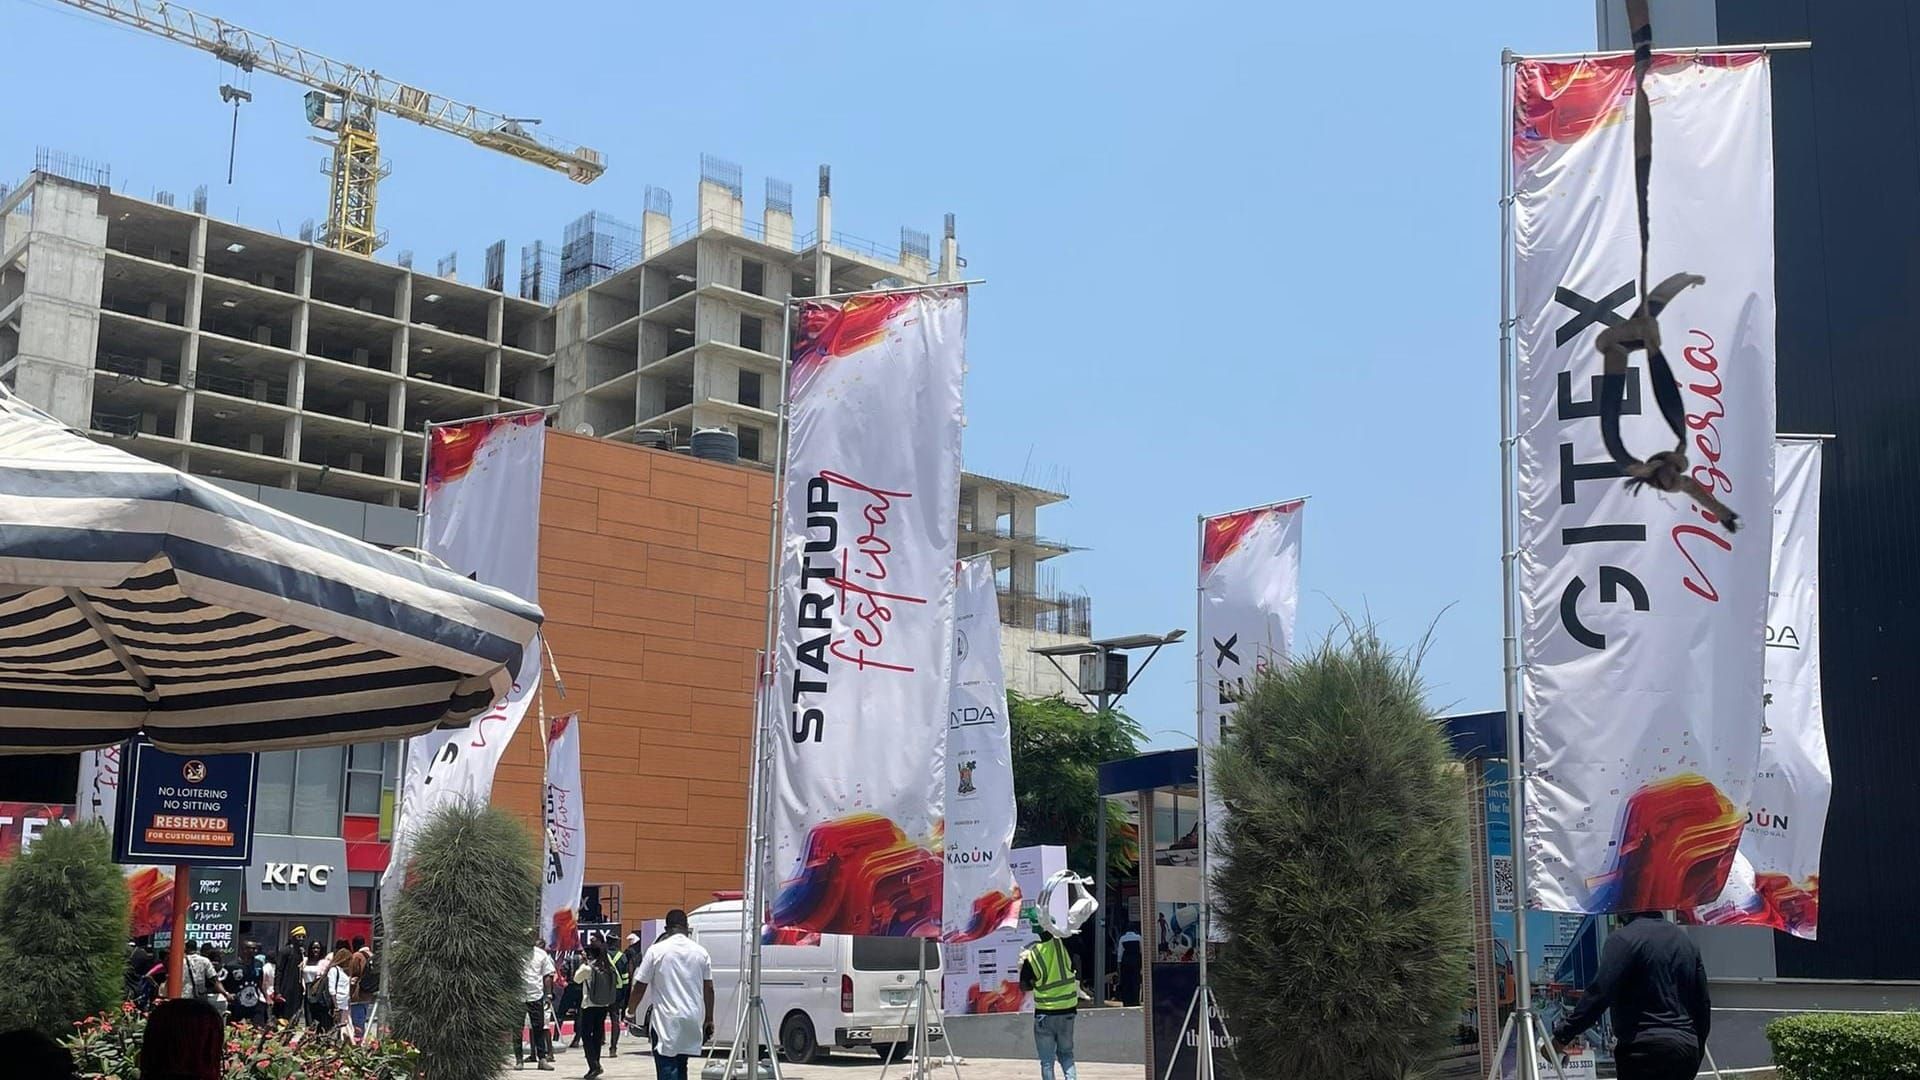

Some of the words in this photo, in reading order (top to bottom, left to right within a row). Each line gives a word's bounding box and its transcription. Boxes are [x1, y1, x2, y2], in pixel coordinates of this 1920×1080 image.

[1554, 279, 1650, 650] GITEX
[1671, 329, 1733, 602] Nigeria
[820, 470, 927, 672] festival
[792, 477, 838, 743] STARTUP
[158, 786, 174, 797] NO
[177, 788, 228, 799] LOITERING
[163, 799, 180, 810] NO
[182, 800, 221, 811] SITTING
[156, 815, 226, 830] RESERVED
[148, 831, 163, 839] FOR
[165, 832, 211, 841] CUSTOMERS
[212, 834, 232, 842] ONLY
[262, 862, 330, 887] KFC
[190, 901, 228, 912] GITEX
[185, 923, 205, 931] ECH
[206, 923, 233, 931] EXPO
[189, 931, 232, 940] FUTURE
